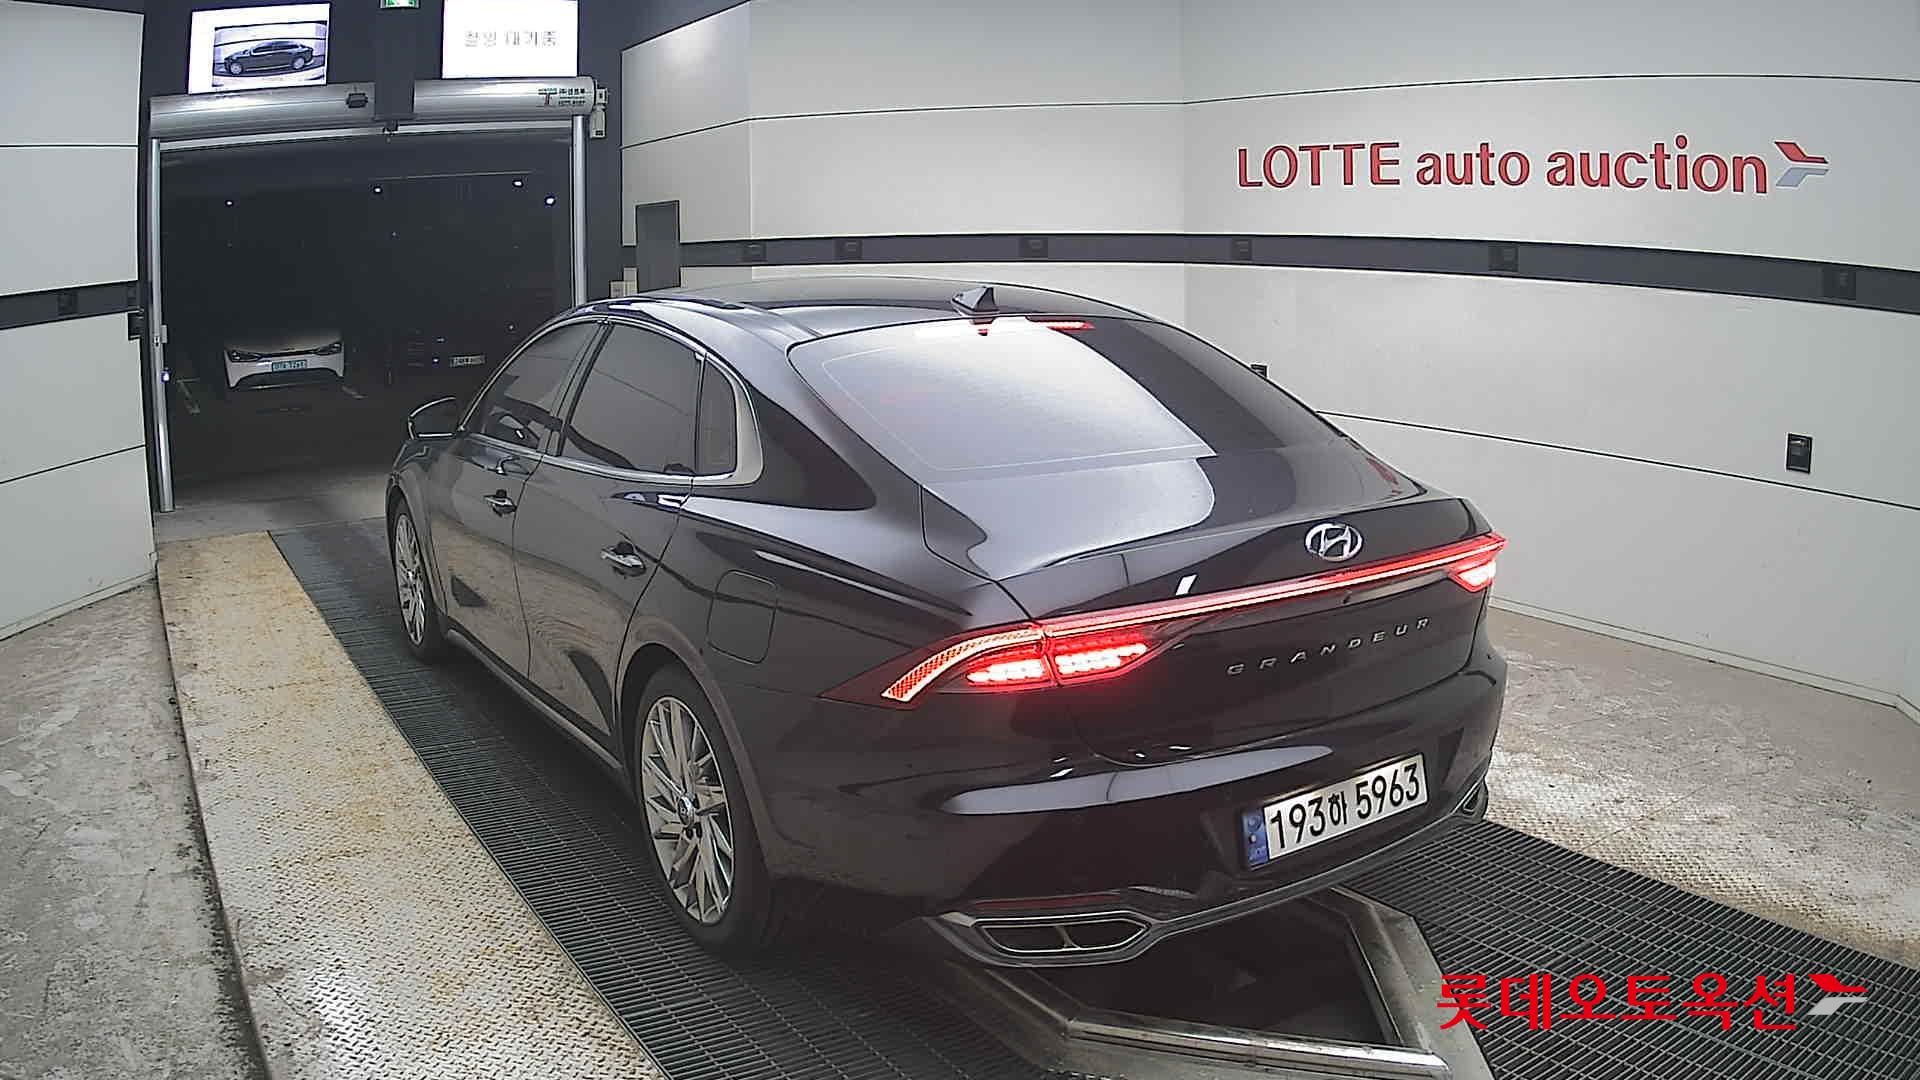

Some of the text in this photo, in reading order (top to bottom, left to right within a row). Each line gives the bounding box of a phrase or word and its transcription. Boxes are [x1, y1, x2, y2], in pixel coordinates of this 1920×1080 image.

[1237, 135, 1768, 194] LOTTE auto auction
[1226, 616, 1430, 675] GRANDEUR
[1270, 763, 1420, 849] 193하 5963
